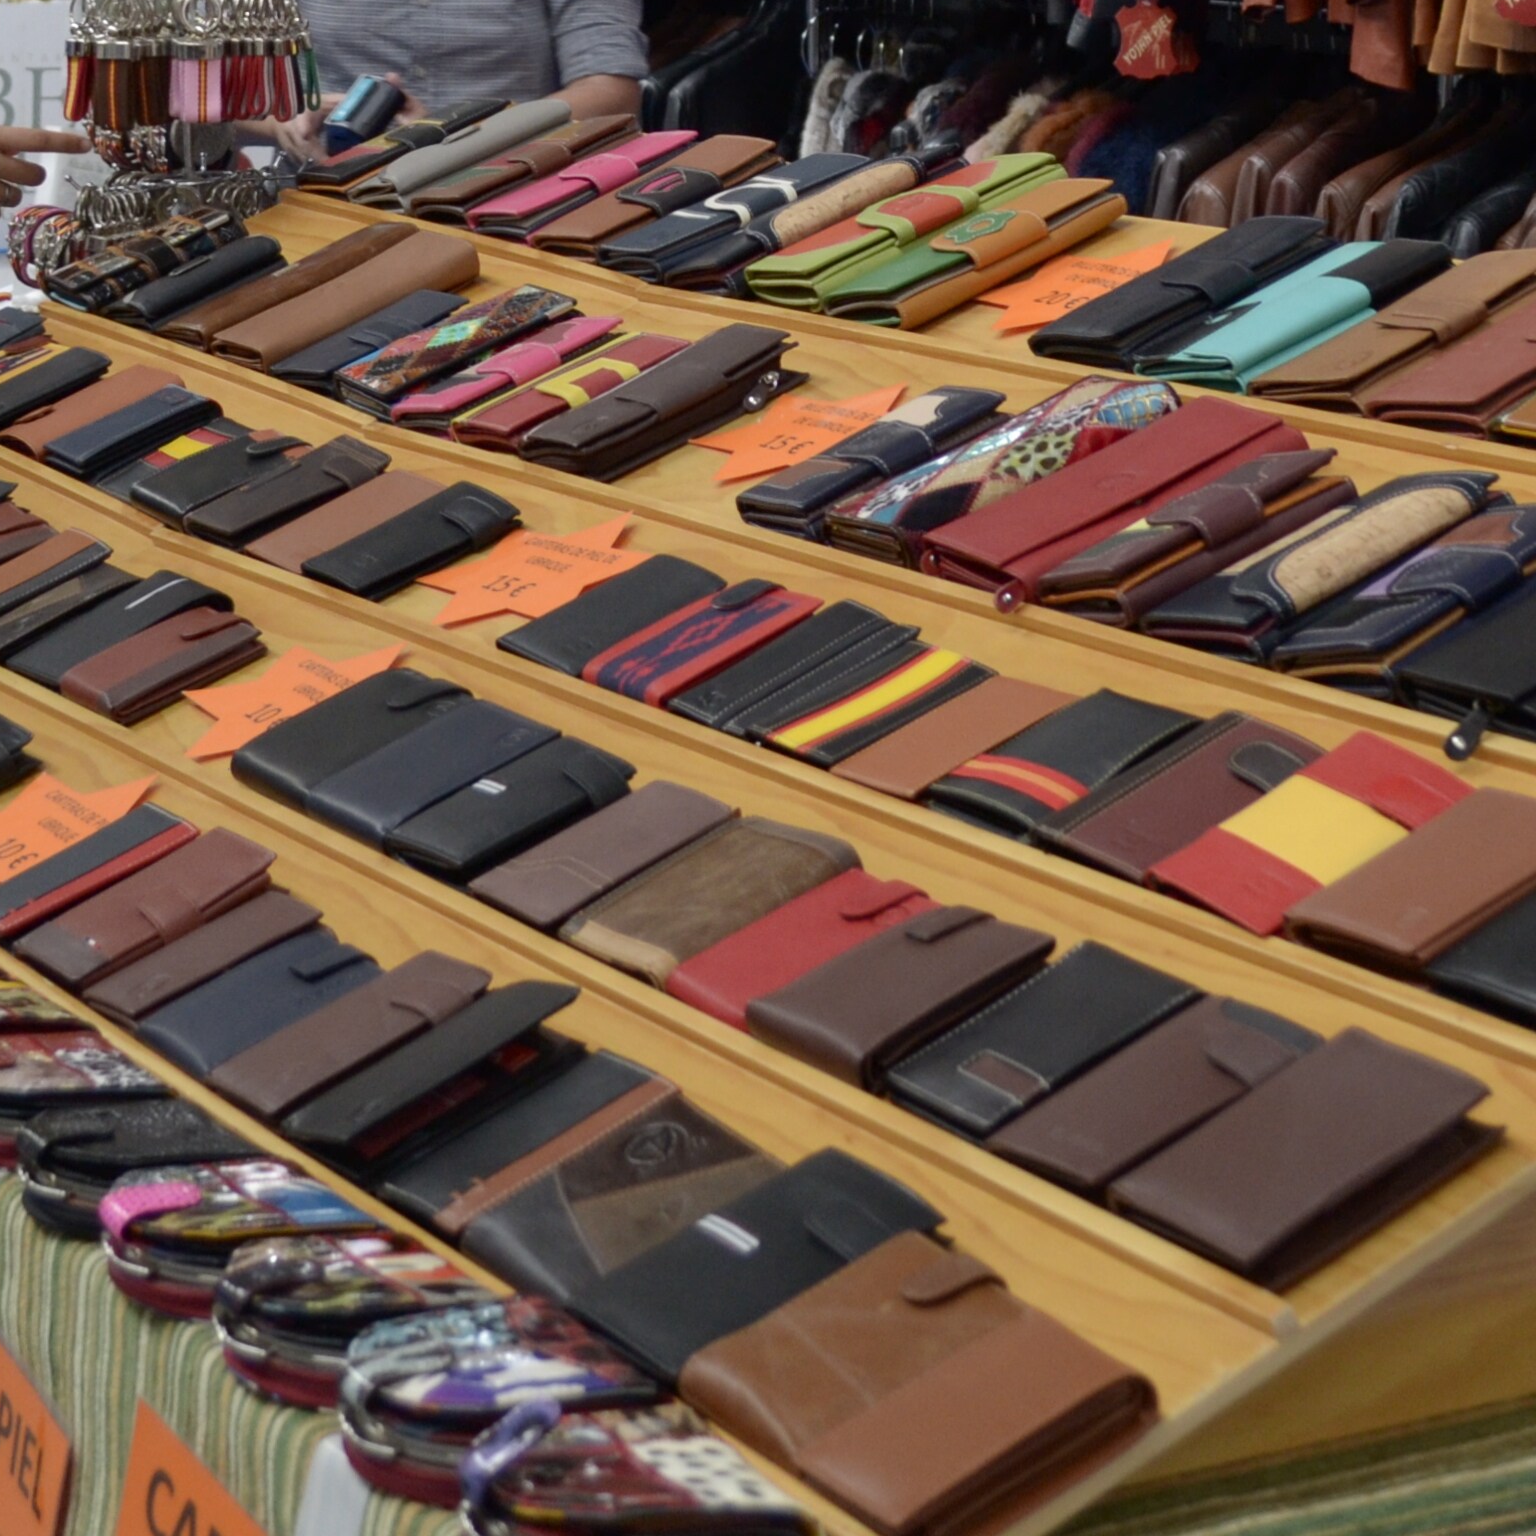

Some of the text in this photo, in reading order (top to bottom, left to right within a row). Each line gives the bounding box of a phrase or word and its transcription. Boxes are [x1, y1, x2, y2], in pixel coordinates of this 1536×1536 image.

[1033, 290, 1090, 309] 20 €
[758, 434, 815, 455] 15 €
[481, 575, 537, 598] 15 €
[244, 703, 283, 724] 10
[8, 852, 39, 870] €
[145, 1468, 220, 1536] CA
